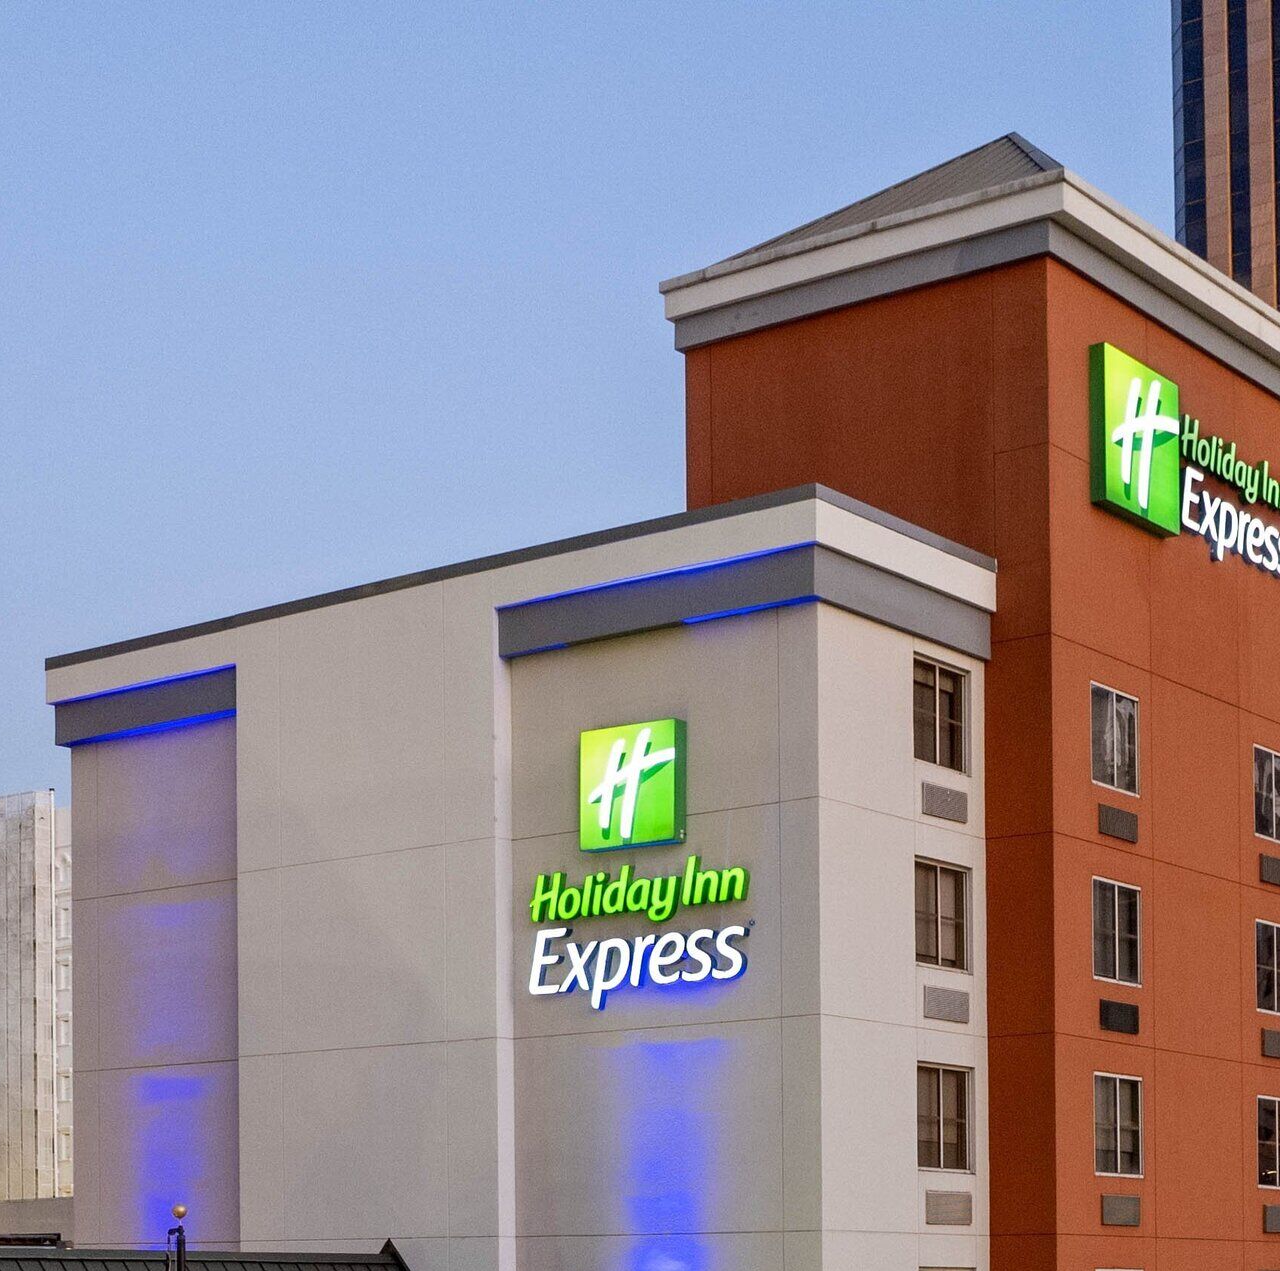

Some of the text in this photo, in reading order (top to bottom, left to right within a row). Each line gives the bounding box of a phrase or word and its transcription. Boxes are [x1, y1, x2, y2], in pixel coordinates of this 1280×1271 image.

[1182, 414, 1260, 504] Holiday
[529, 855, 748, 922] Holiday Inn
[528, 925, 749, 1010] Express
